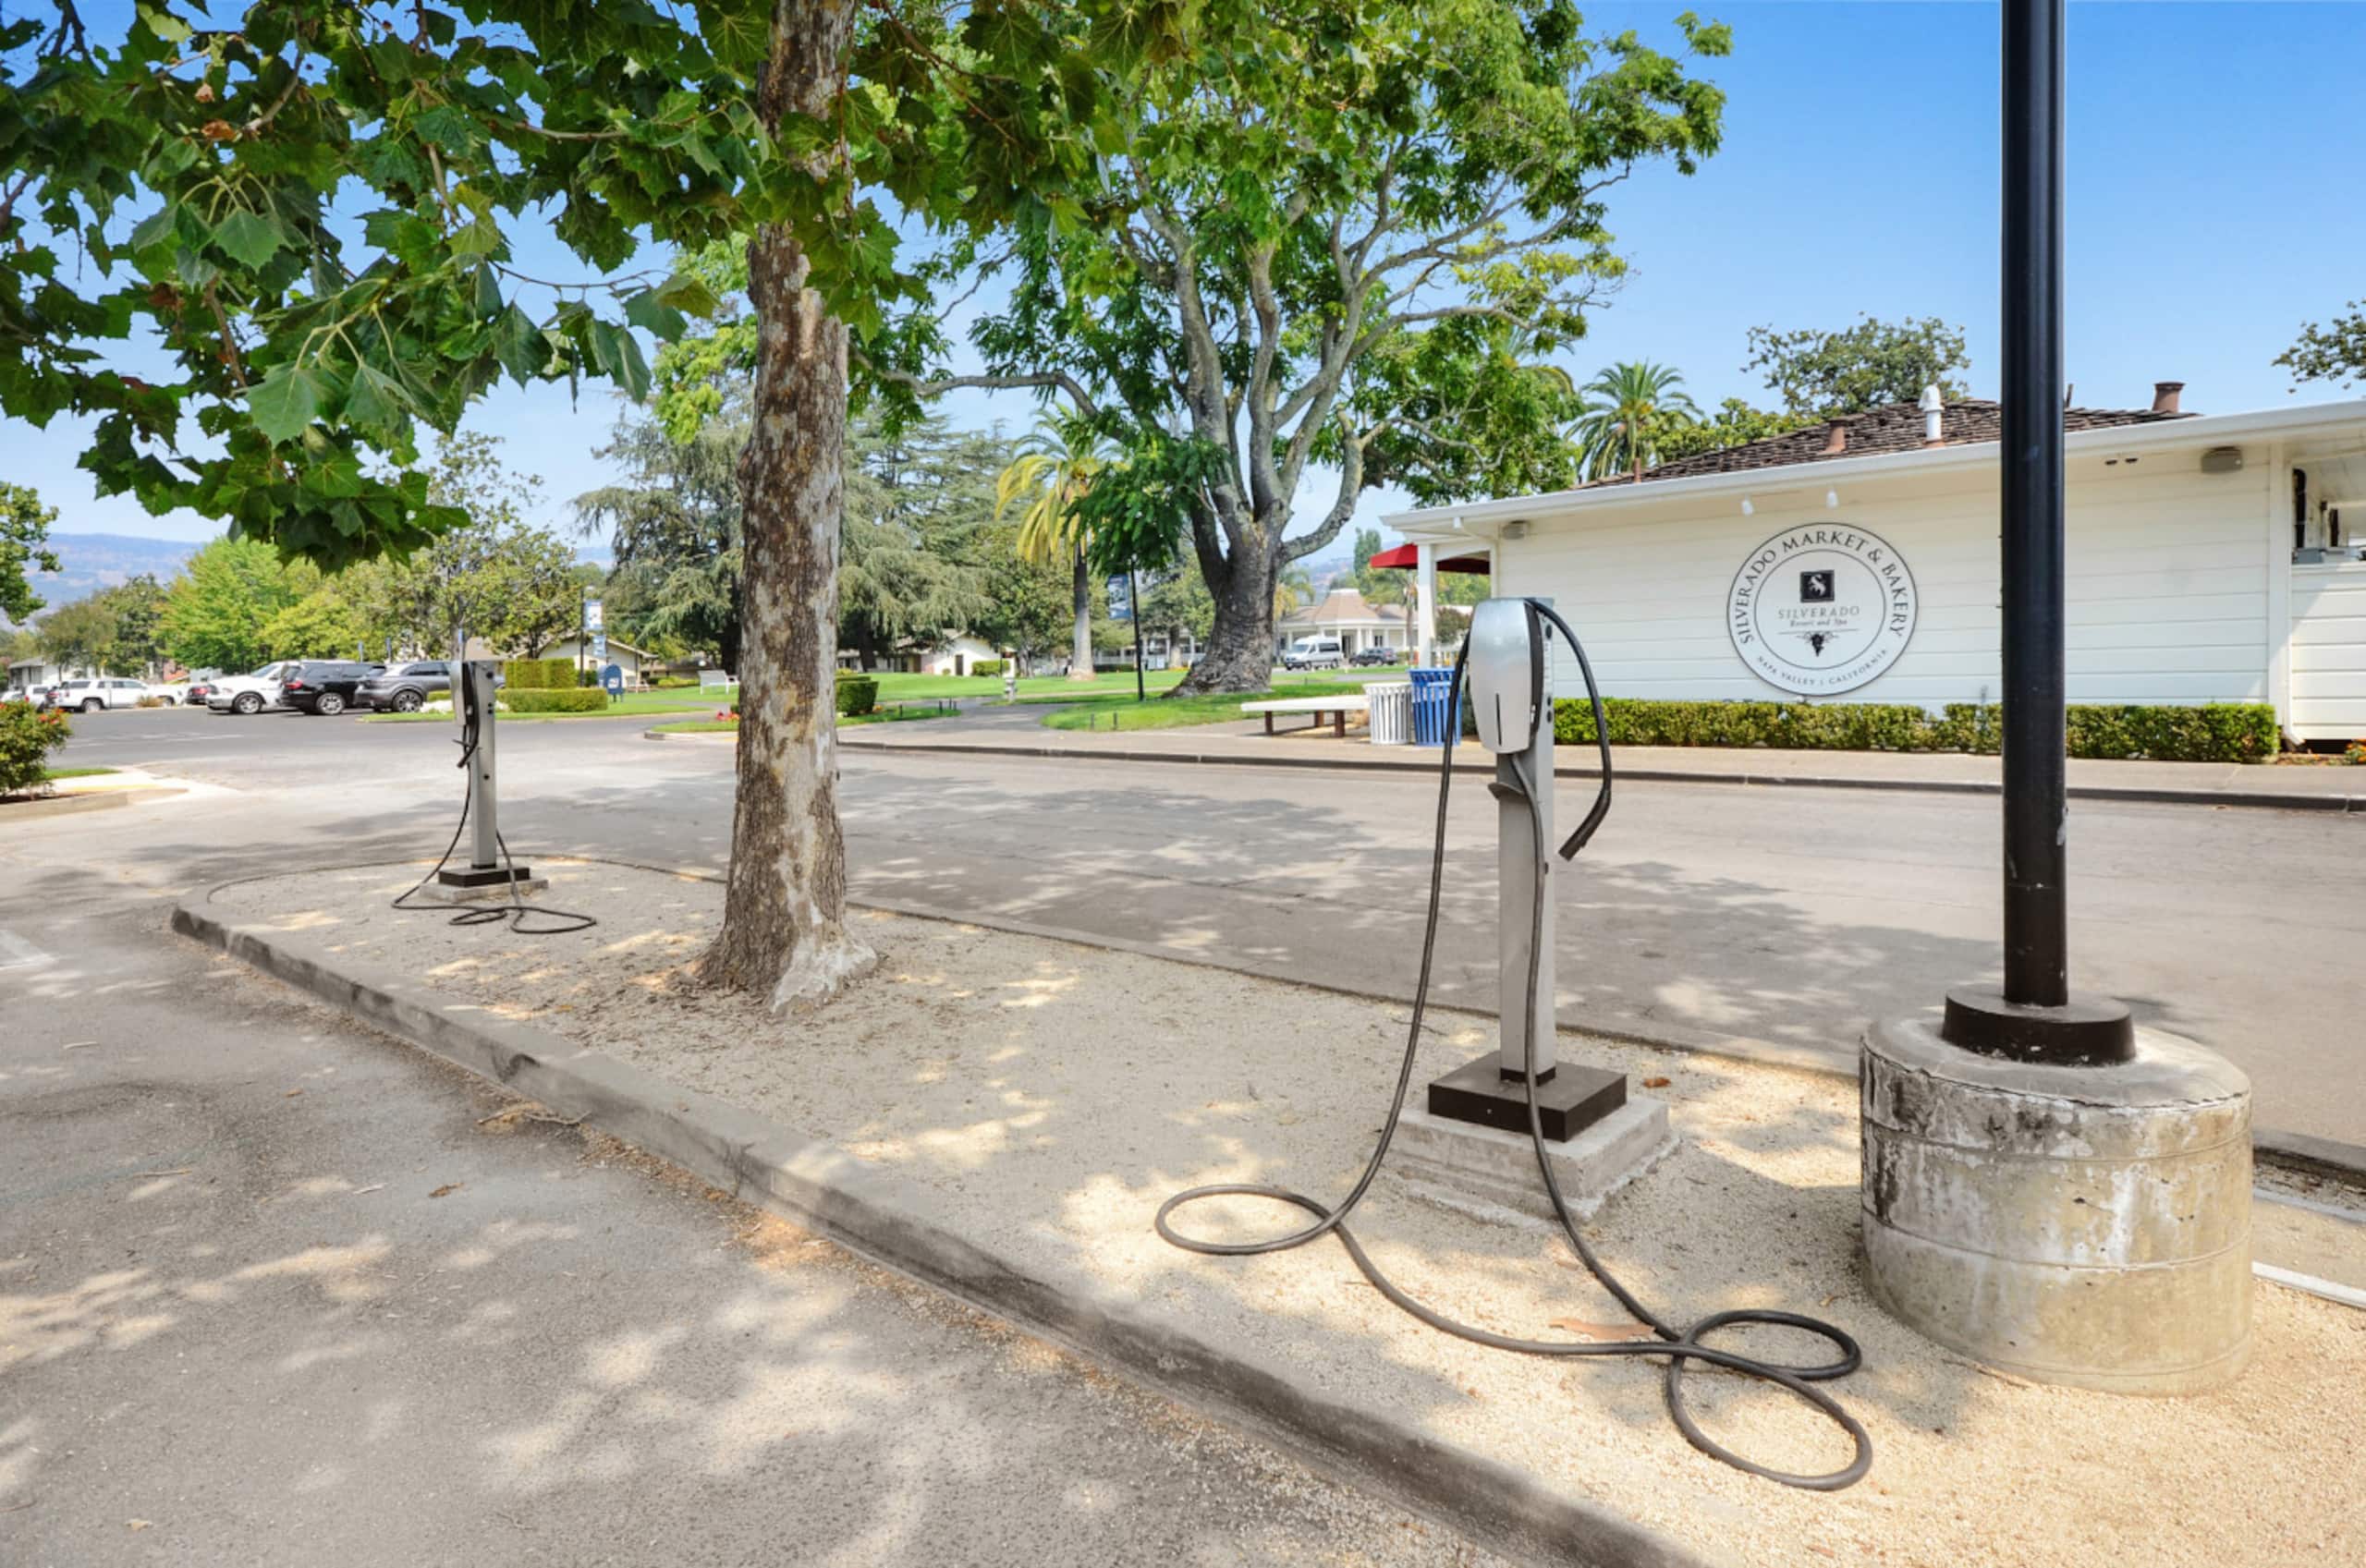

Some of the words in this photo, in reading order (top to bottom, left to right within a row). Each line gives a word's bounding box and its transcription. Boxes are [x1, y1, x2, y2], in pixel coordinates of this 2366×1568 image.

[1735, 549, 1777, 645] SILVERADO
[1782, 530, 1869, 553] MARKET
[1867, 548, 1884, 565] &
[1881, 563, 1909, 638] BAKERY
[1778, 605, 1860, 619] SILVERADO
[1758, 656, 1777, 675] NAPA
[1781, 672, 1814, 686] VALLEY
[1829, 649, 1887, 685] CALIFORNIA
